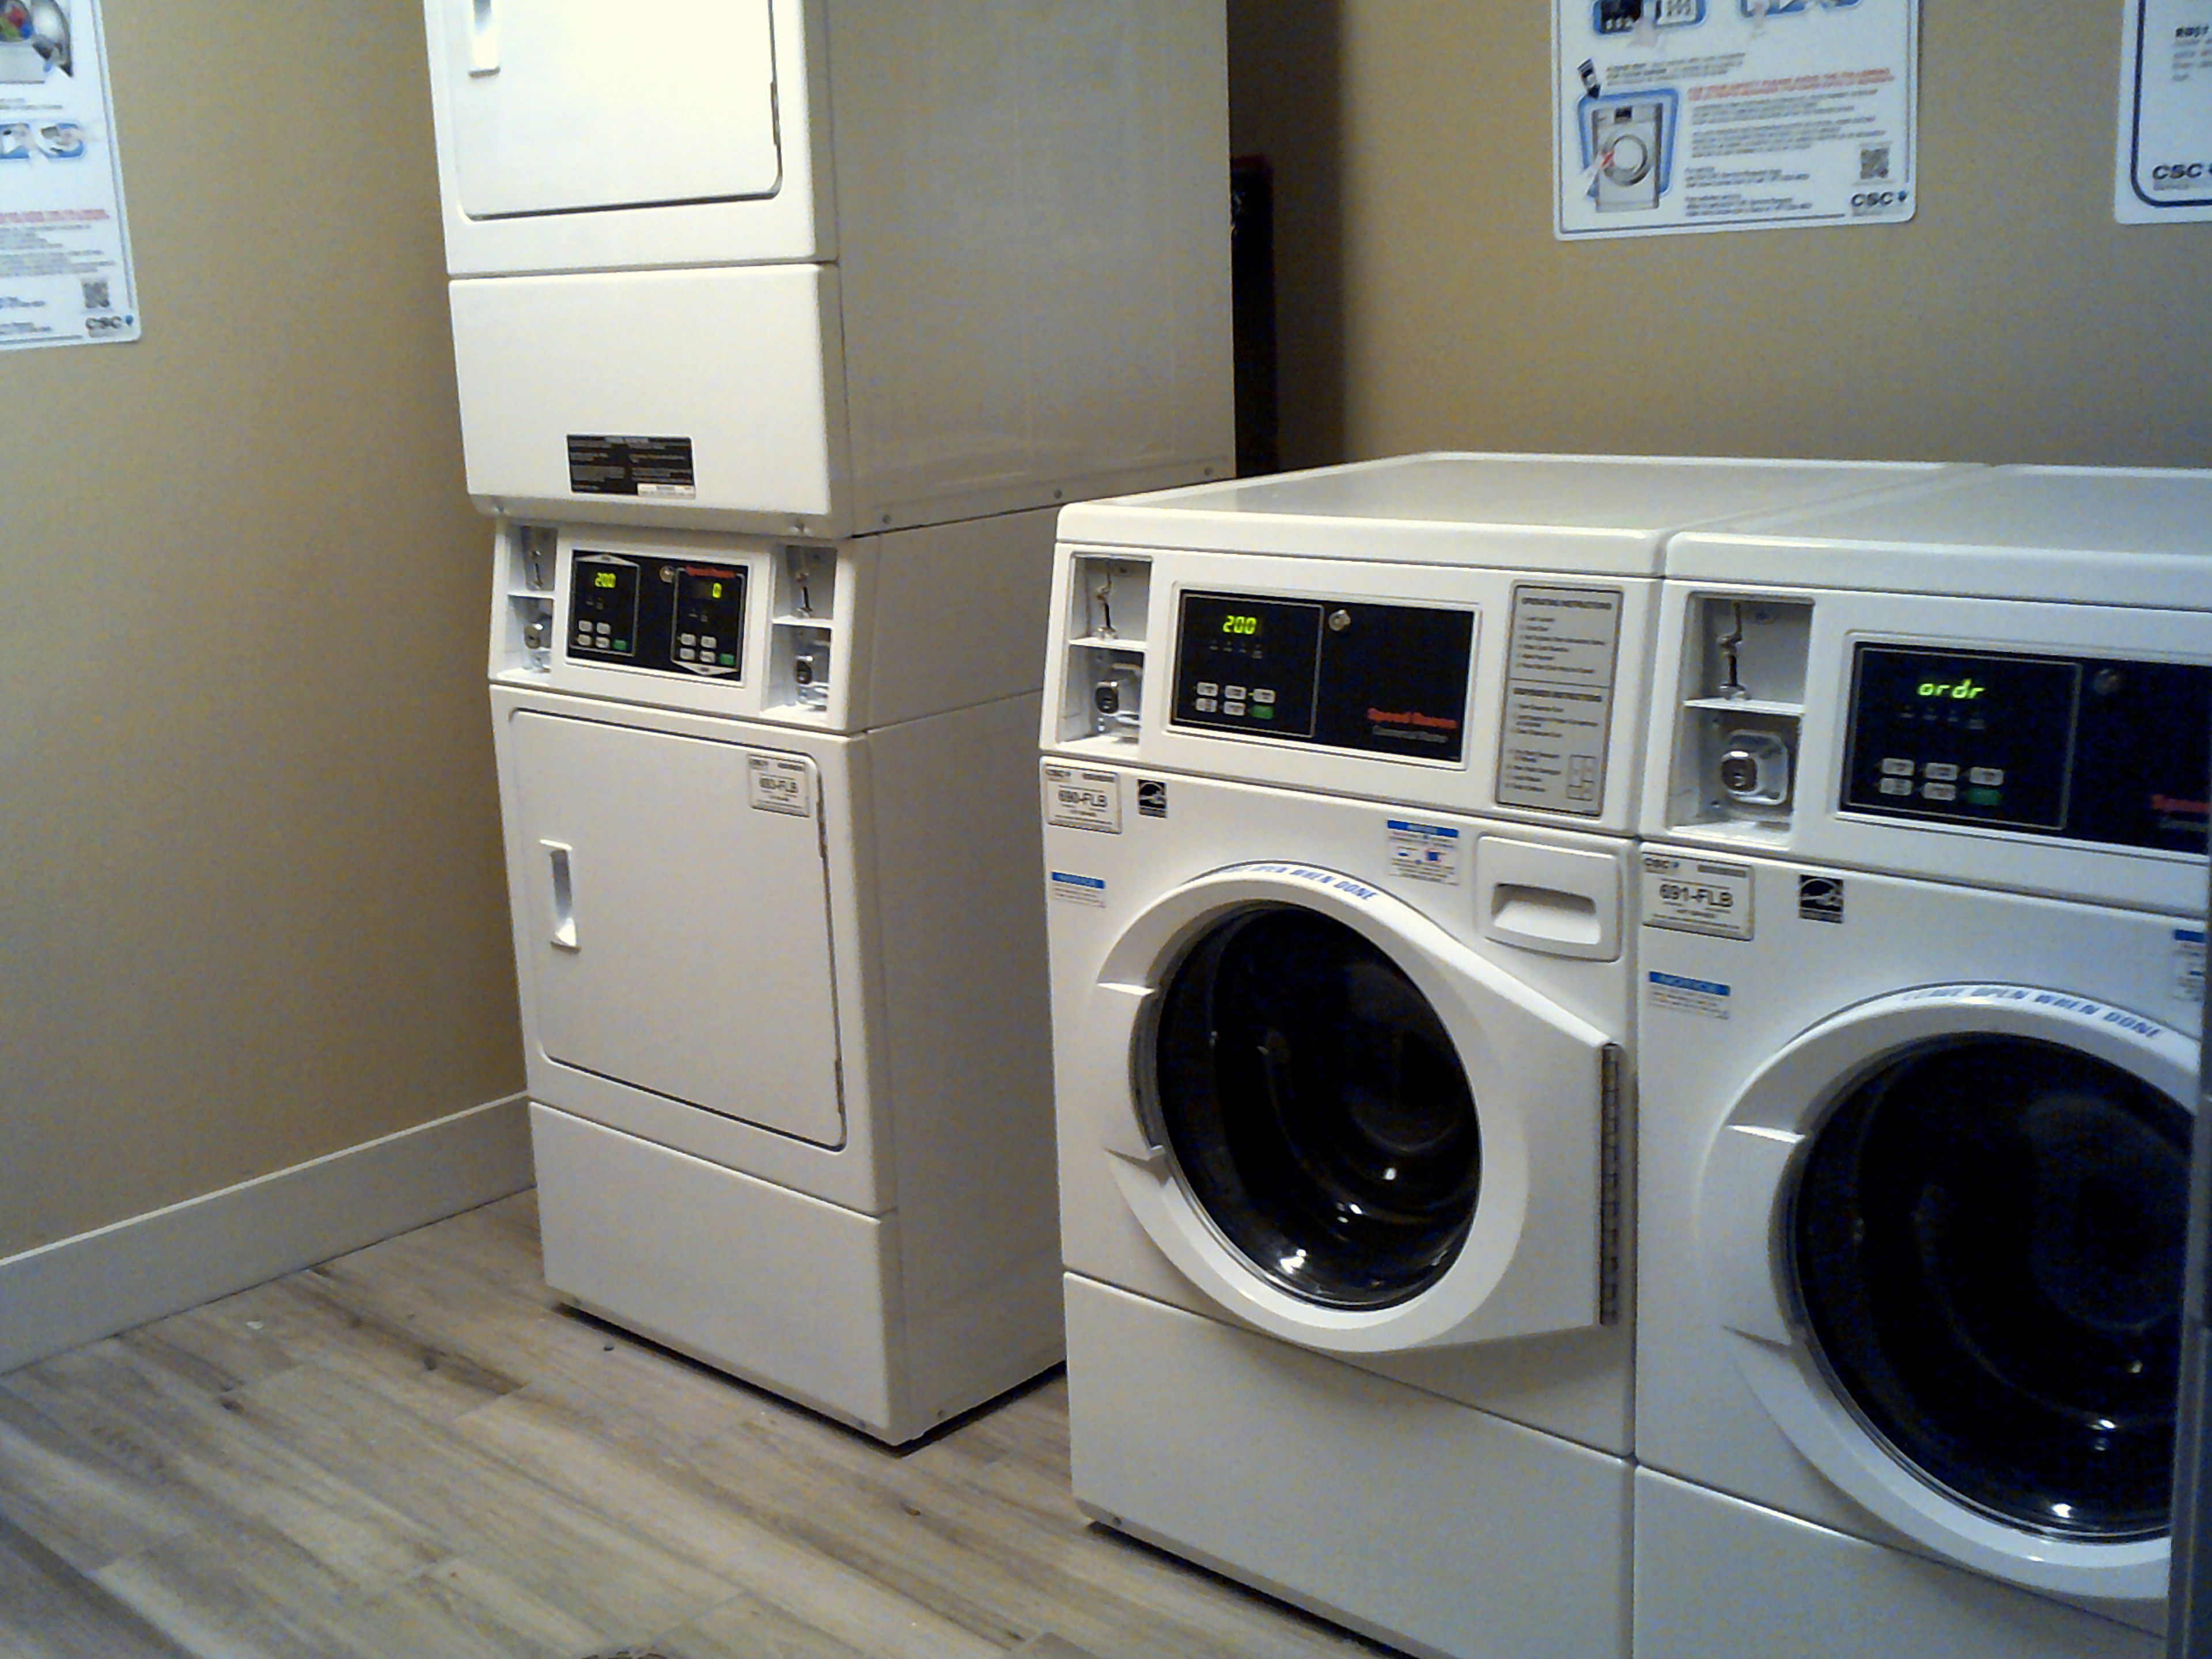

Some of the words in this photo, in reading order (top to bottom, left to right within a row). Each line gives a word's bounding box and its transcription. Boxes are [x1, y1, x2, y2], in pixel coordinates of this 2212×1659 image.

[2153, 164, 2202, 180] CSC
[1851, 191, 1893, 207] CSC
[1222, 615, 1257, 635] 200
[1918, 679, 1985, 699] ordr
[1659, 884, 1734, 908] 691-FLB
